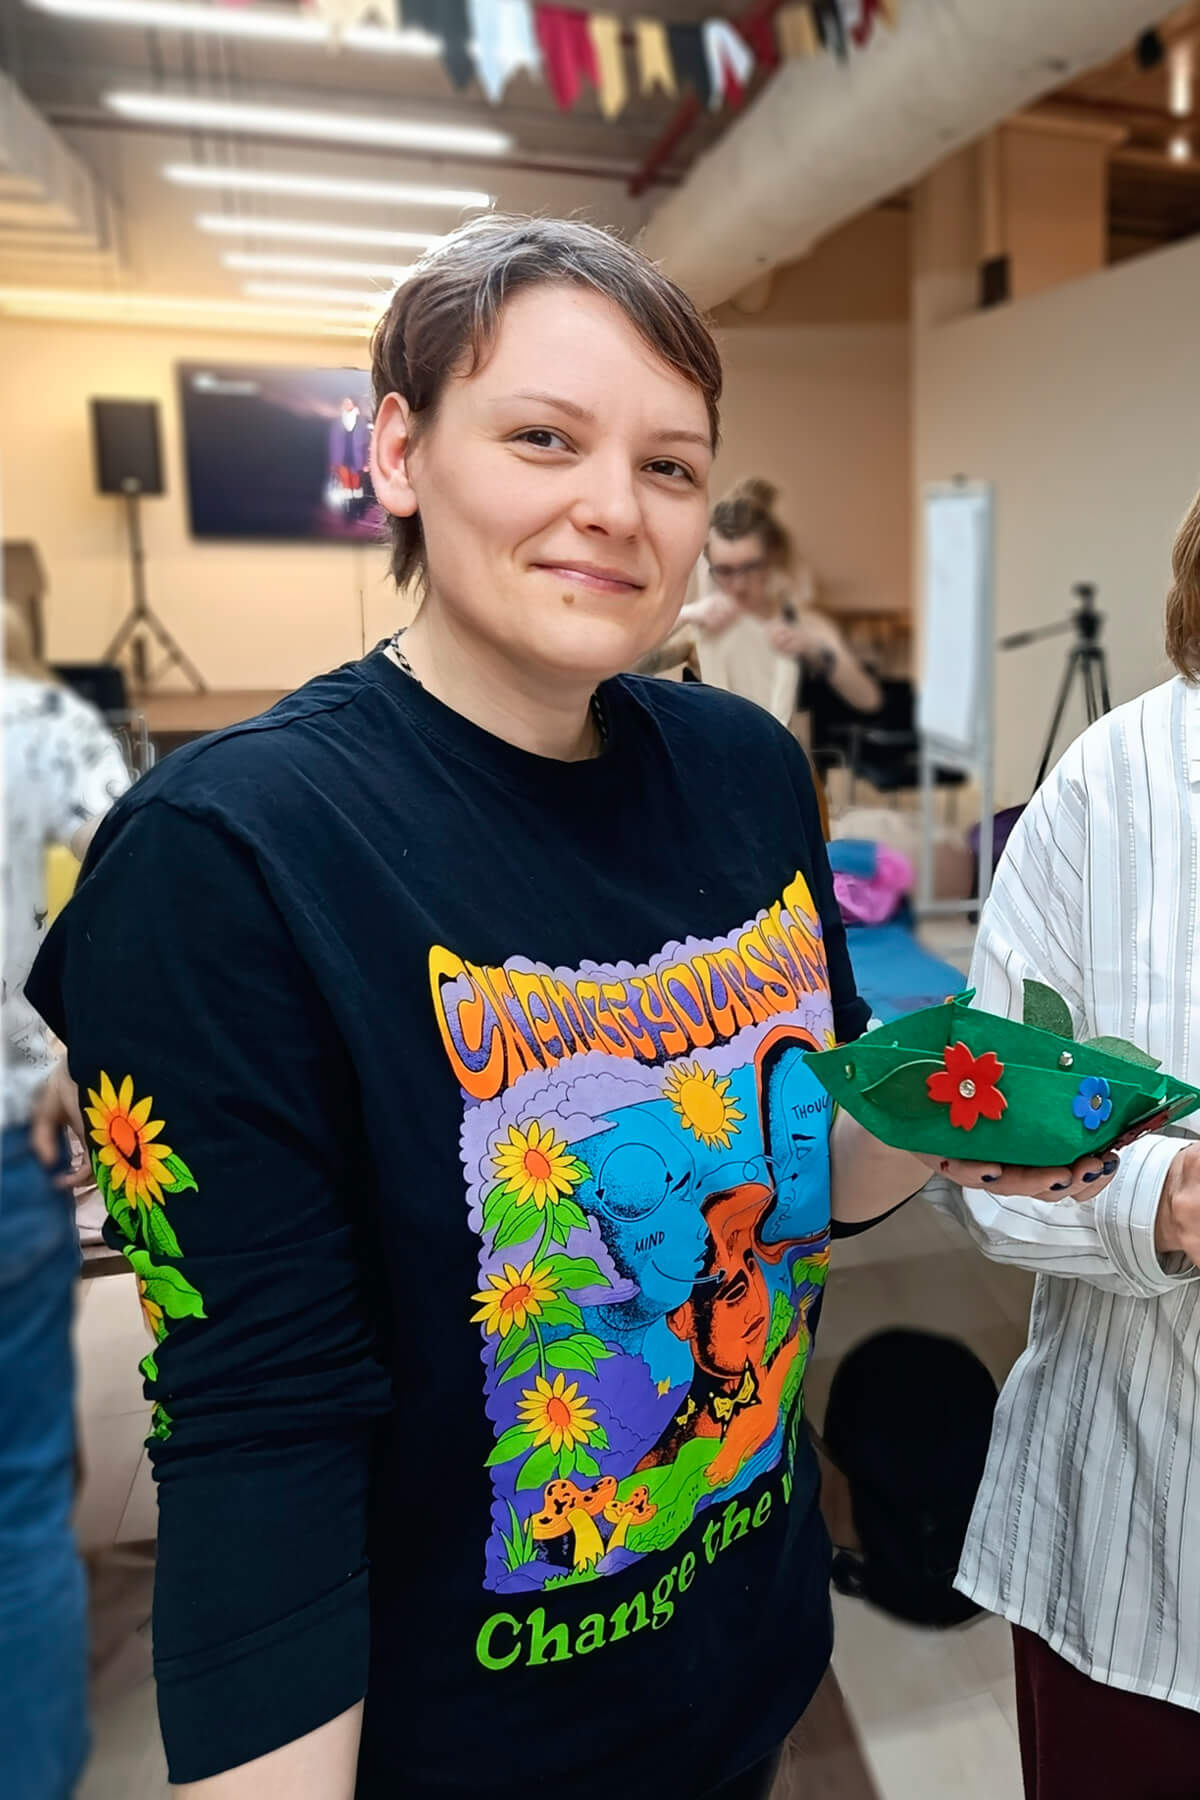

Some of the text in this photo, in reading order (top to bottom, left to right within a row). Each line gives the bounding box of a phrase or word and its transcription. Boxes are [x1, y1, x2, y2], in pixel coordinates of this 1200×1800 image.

[633, 1231, 665, 1256] MIND
[476, 1491, 771, 1671] Change the
